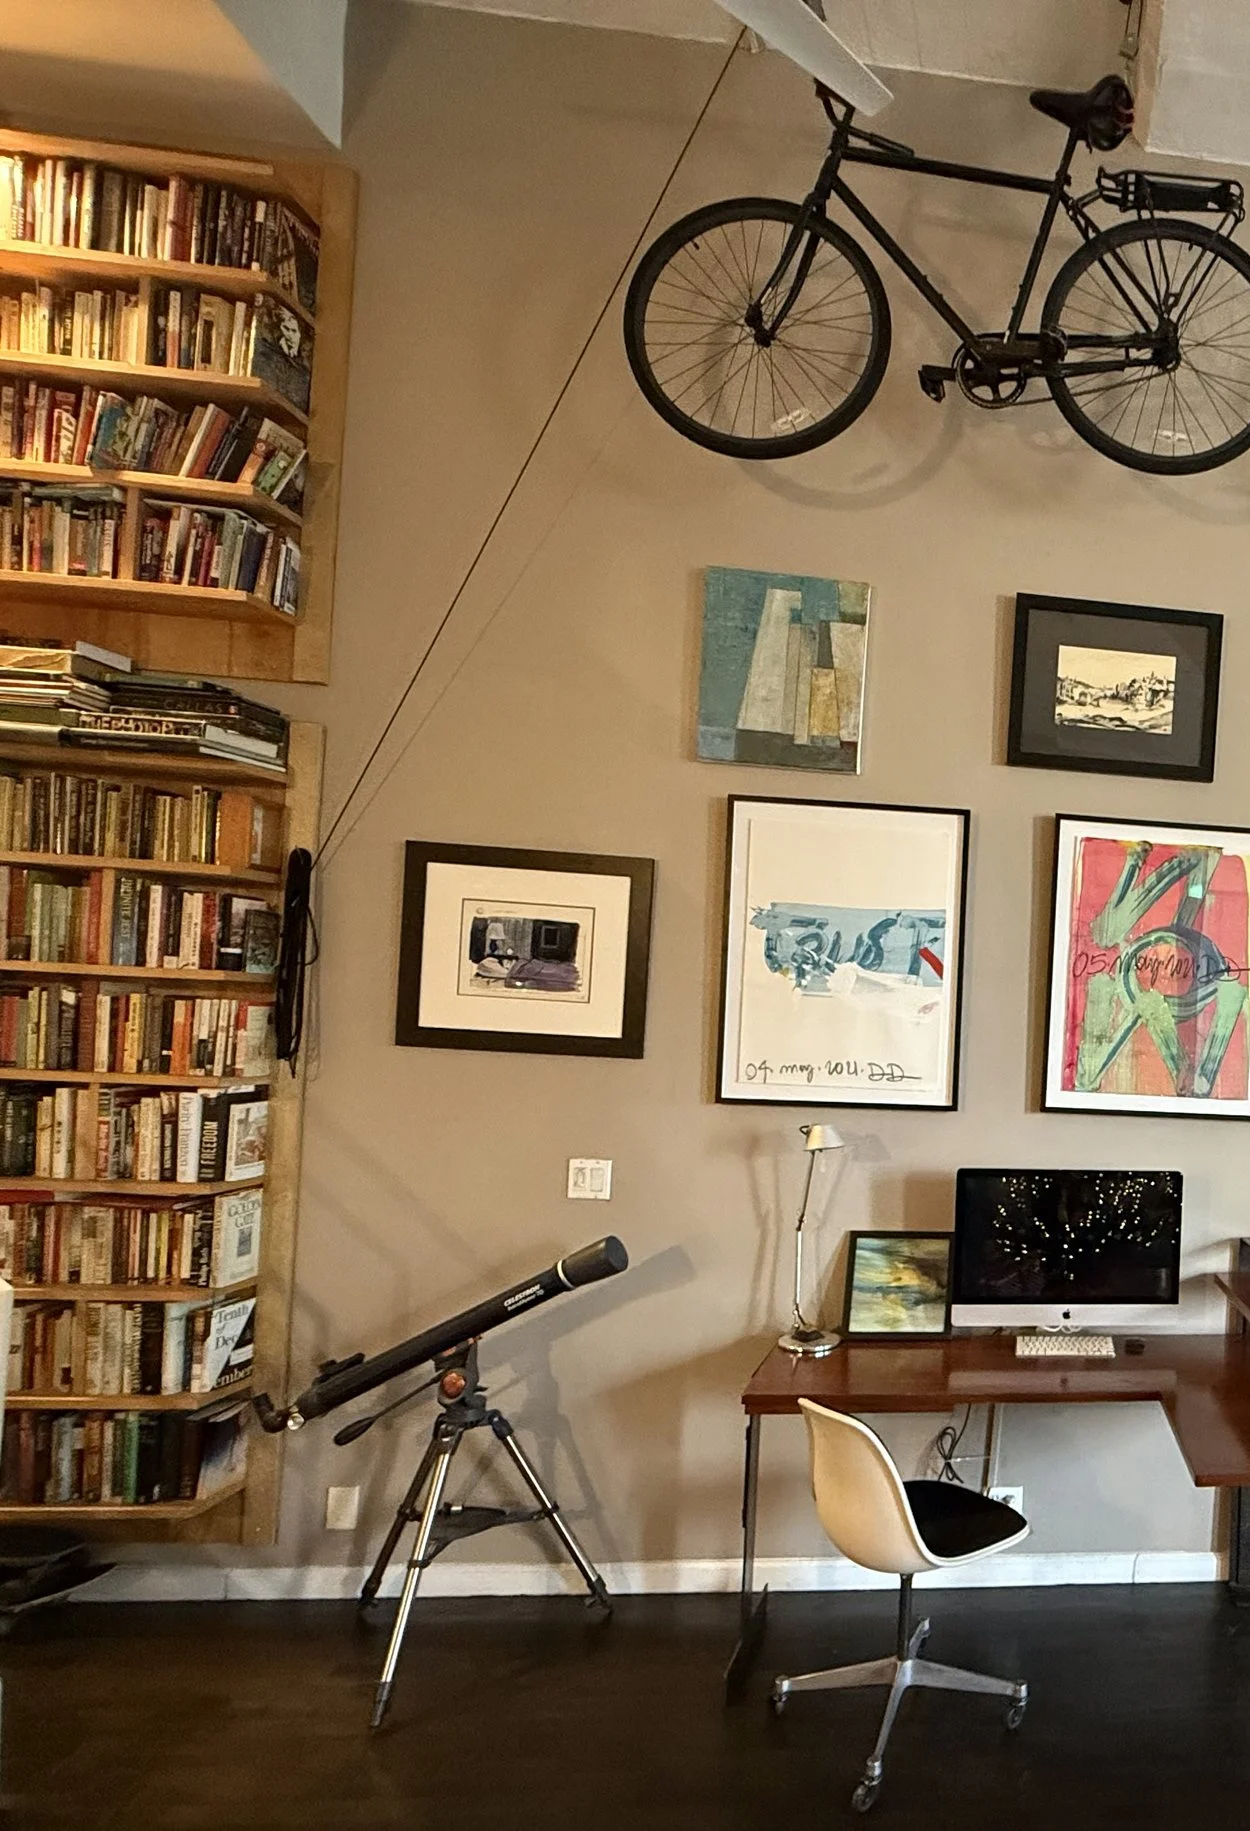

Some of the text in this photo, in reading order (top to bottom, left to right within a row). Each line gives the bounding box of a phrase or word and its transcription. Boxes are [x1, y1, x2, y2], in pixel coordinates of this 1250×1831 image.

[164, 700, 222, 714] CALLAS
[200, 1121, 218, 1165] FREEDOM
[504, 1284, 540, 1307] CELESTRON
[215, 1304, 249, 1324] Tenth
[215, 1335, 239, 1350] Dec
[214, 1366, 253, 1388] ember
